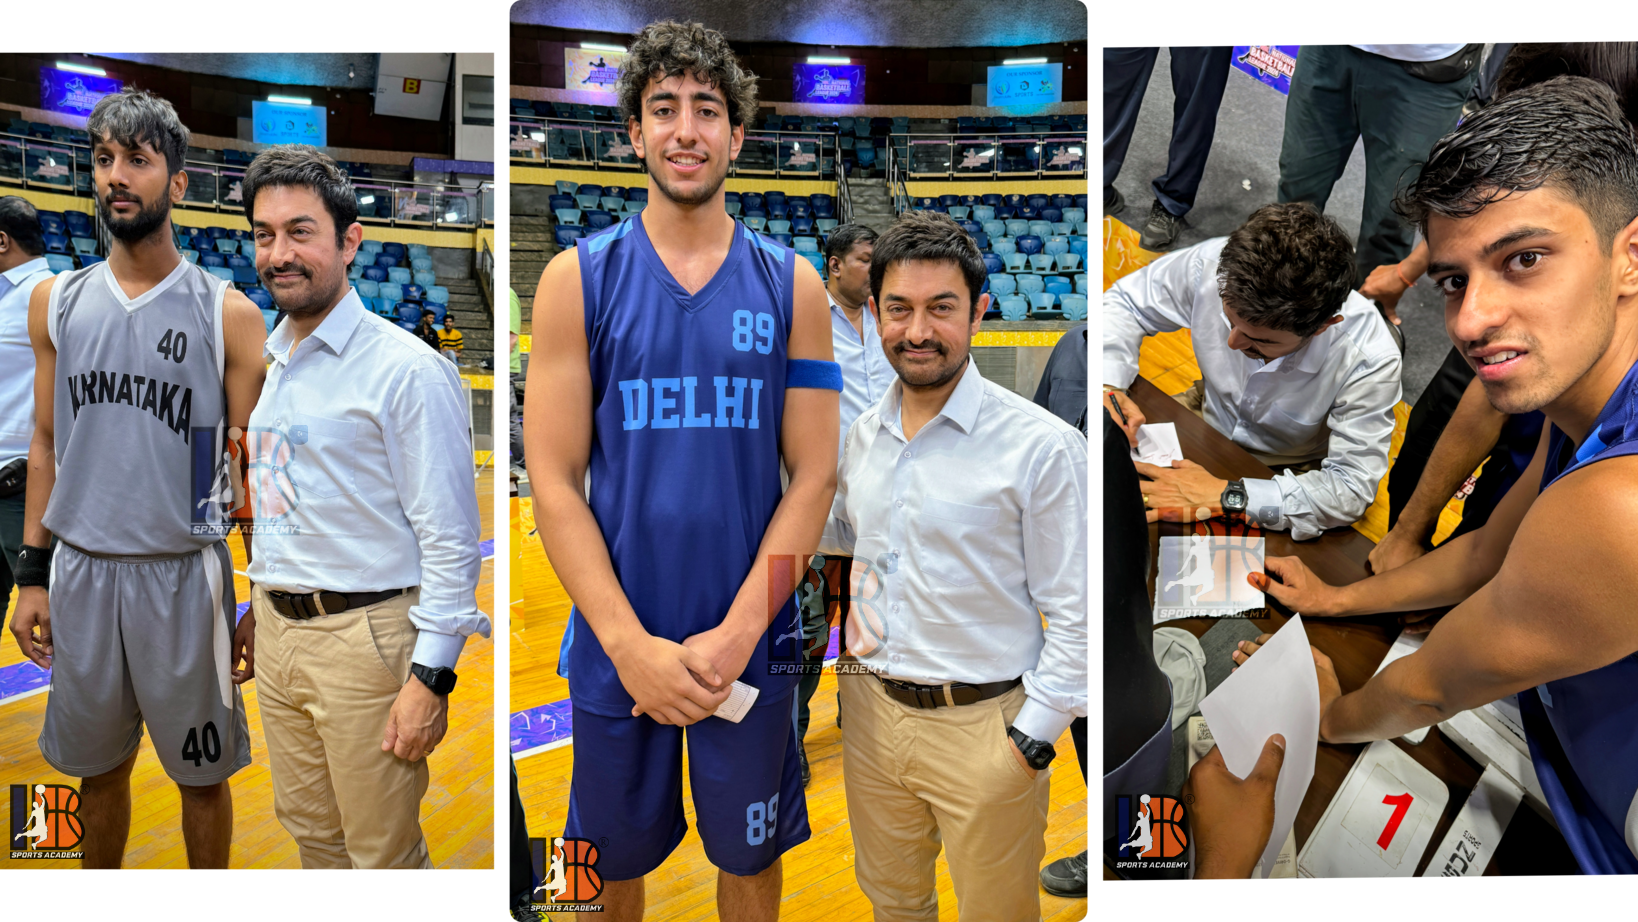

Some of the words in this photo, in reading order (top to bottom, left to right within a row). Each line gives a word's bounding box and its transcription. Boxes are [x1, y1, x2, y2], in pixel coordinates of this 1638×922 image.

[405, 79, 418, 94] B
[815, 83, 851, 92] BASKETBALL
[157, 328, 187, 363] 40
[732, 309, 775, 355] 89
[618, 376, 764, 431] DELHI
[182, 721, 221, 767] 40
[747, 792, 779, 846] 89
[1376, 792, 1414, 851] 1
[1463, 829, 1482, 850] SPORTS
